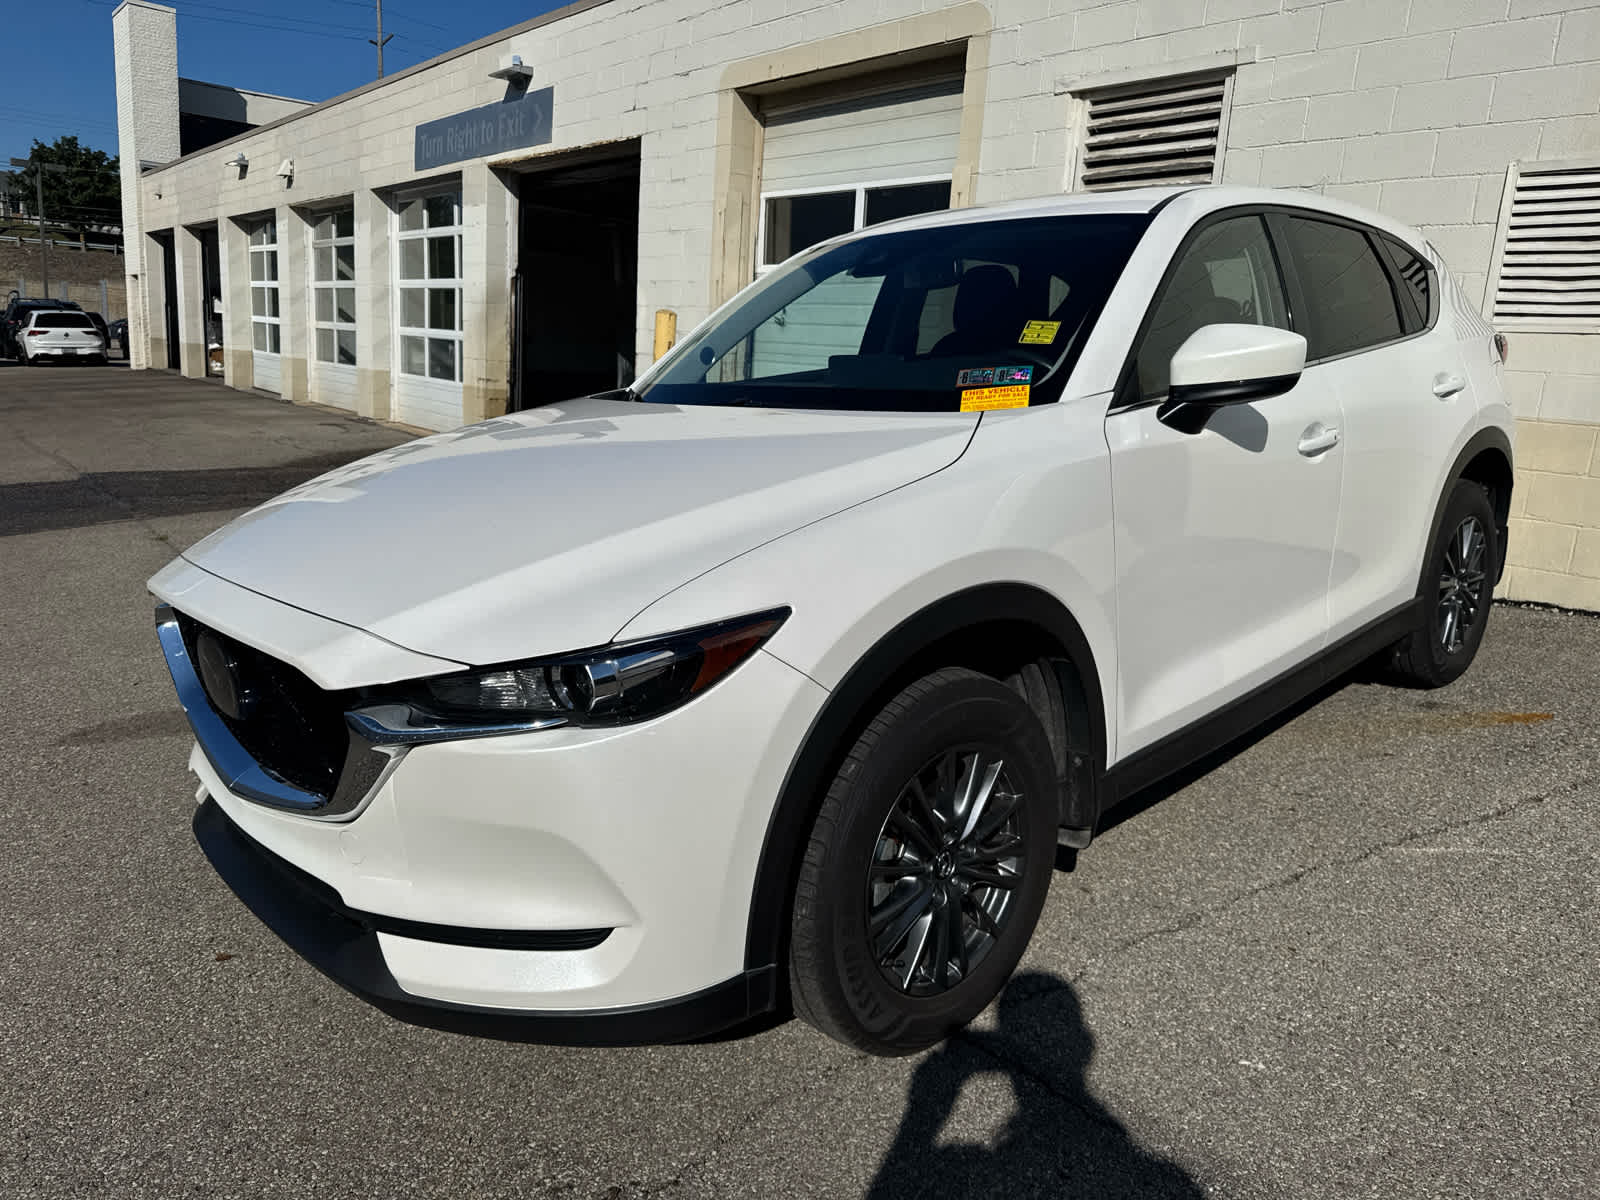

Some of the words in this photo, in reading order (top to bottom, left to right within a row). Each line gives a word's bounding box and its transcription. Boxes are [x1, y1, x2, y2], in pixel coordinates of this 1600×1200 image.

[420, 134, 444, 160] Turn
[447, 120, 477, 156] Right
[481, 119, 495, 145] to
[498, 107, 525, 138] Exit
[988, 386, 1027, 394] VEHICLE
